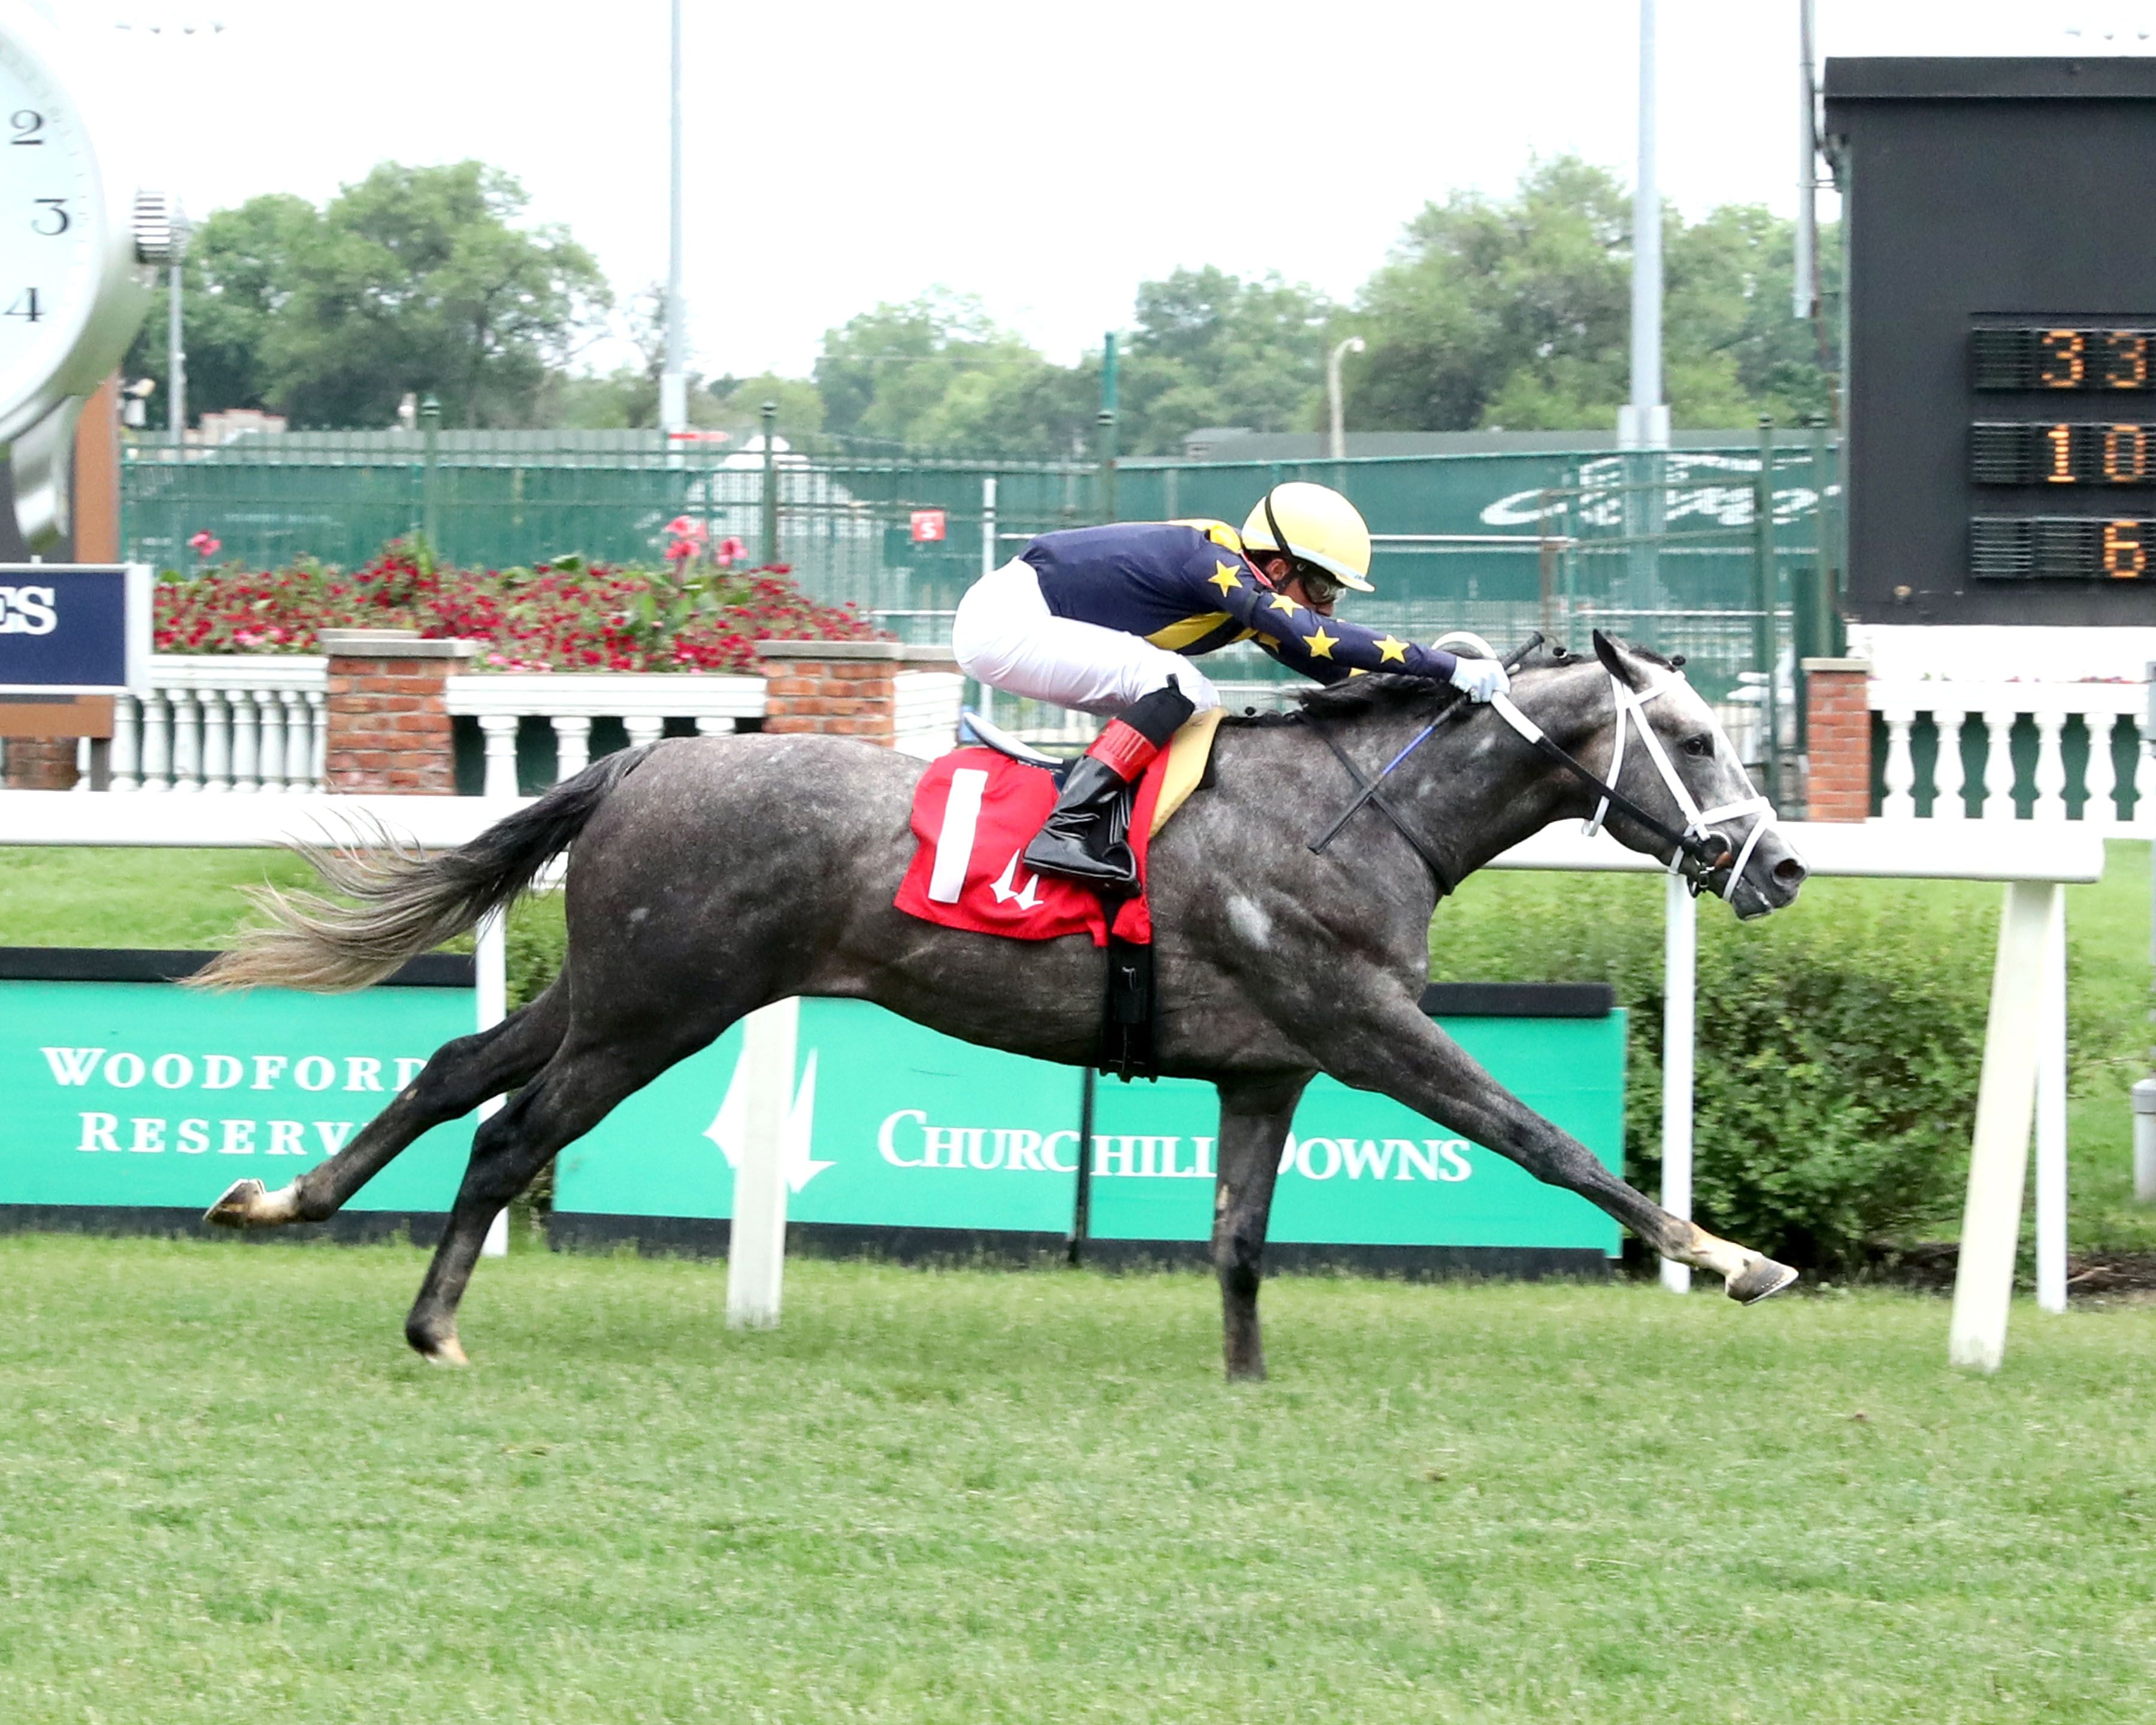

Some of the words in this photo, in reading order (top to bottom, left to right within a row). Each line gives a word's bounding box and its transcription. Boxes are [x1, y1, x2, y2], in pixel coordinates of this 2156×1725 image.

[10, 109, 44, 145] 2
[31, 198, 70, 235] 3
[1, 287, 45, 323] 4
[2041, 329, 2148, 388] 33
[2046, 423, 2146, 483] 10
[2103, 520, 2147, 579] 6
[928, 768, 989, 904] 1
[40, 1046, 428, 1092] WOODFORD
[77, 1111, 370, 1156] RESERV
[1277, 1130, 1472, 1182] OWNS
